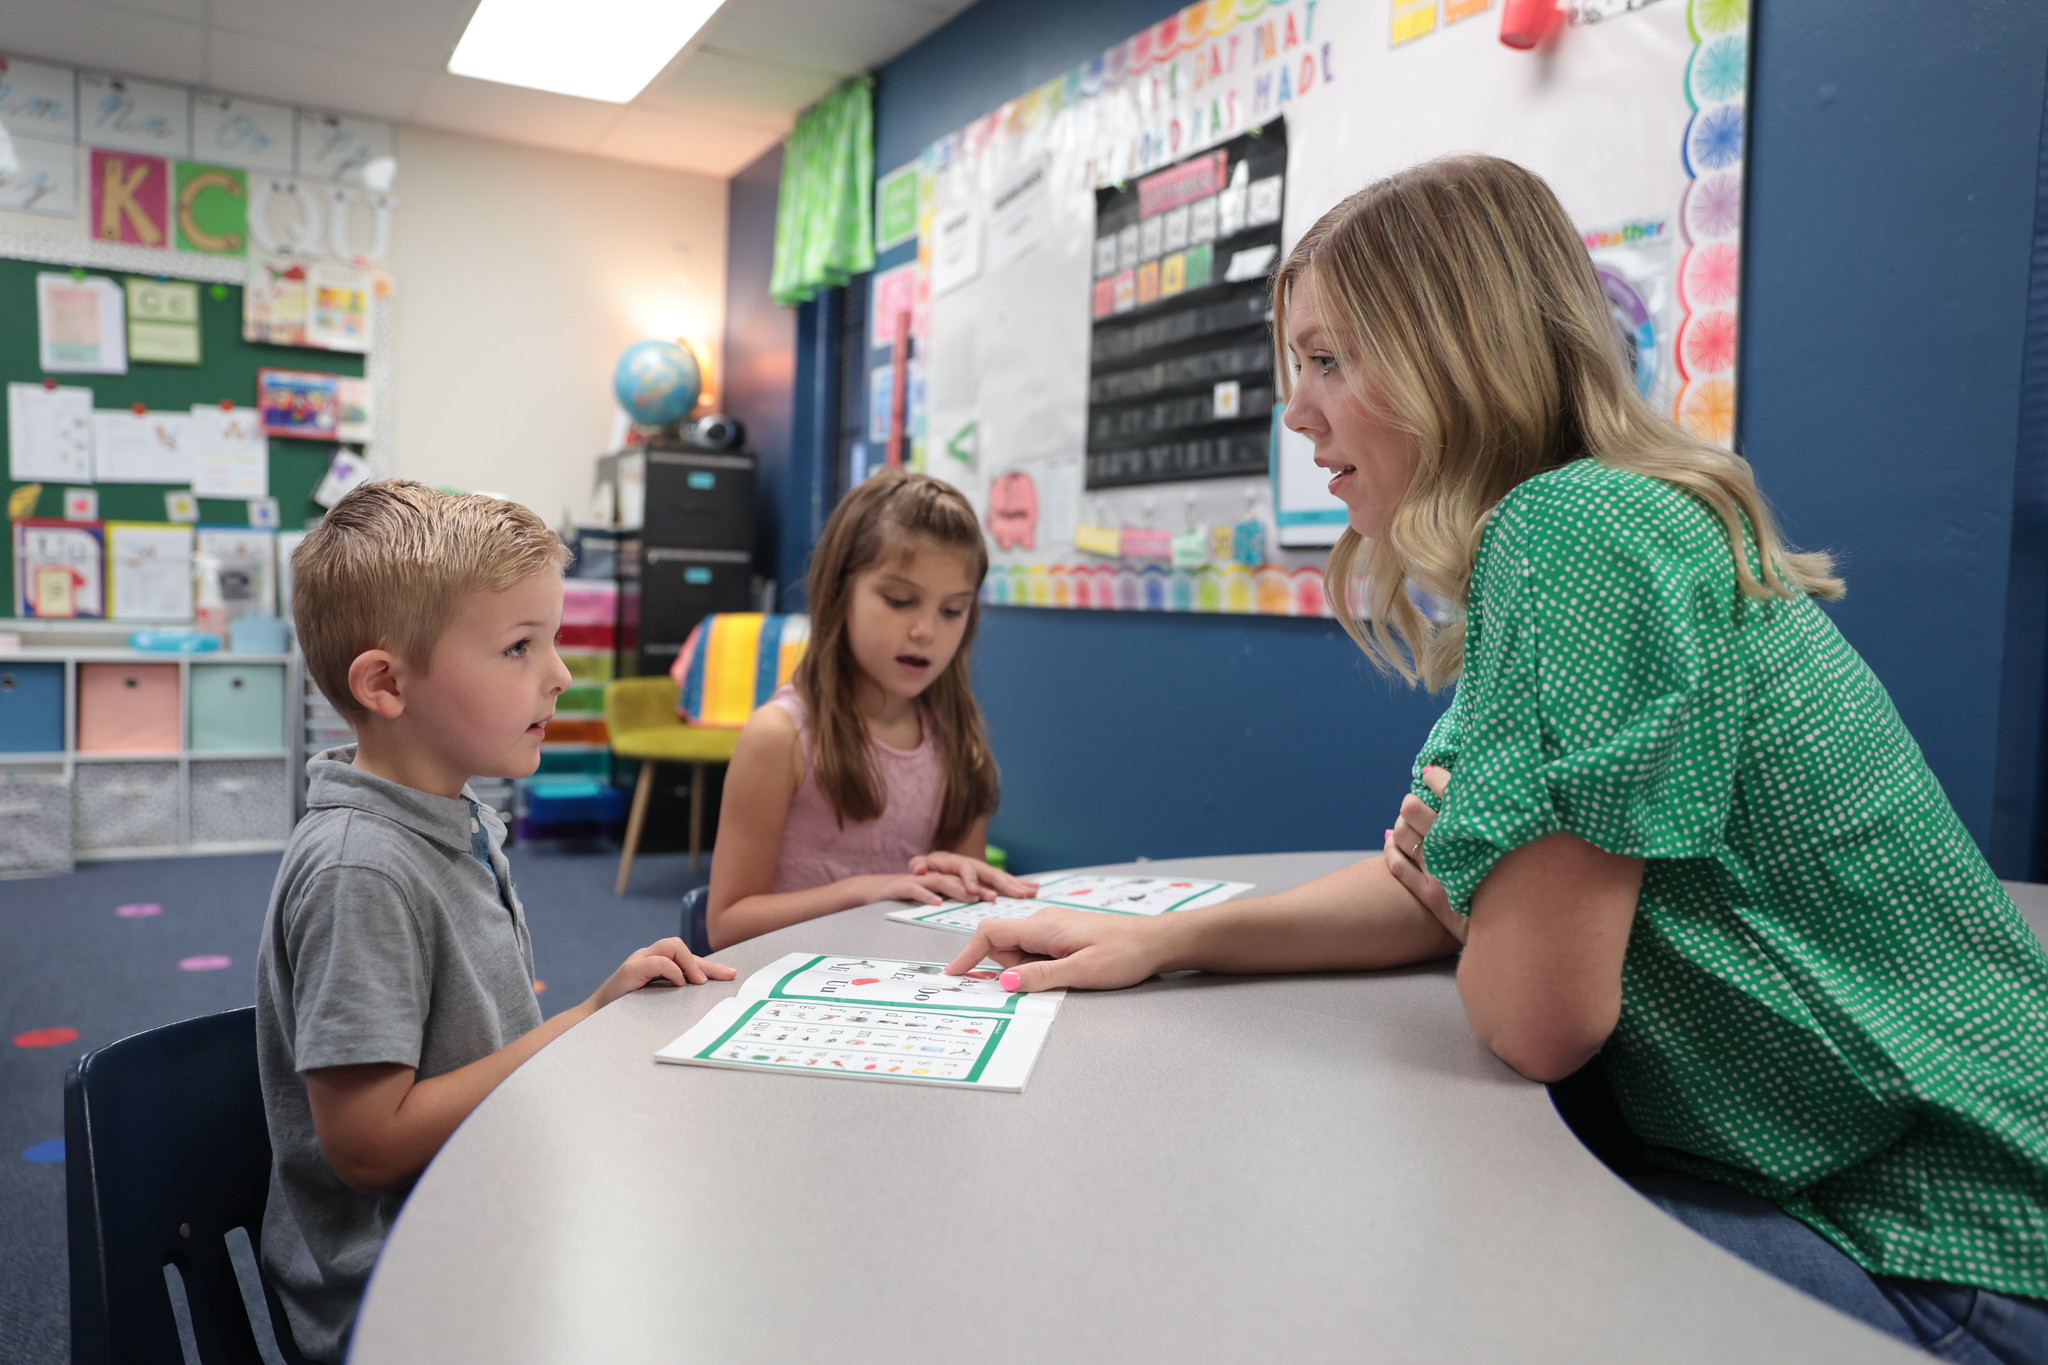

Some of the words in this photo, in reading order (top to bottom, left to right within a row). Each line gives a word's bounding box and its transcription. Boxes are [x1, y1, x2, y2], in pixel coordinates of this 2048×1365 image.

[1194, 35, 1240, 91] DAY
[1253, 41, 1333, 115] MADE
[103, 158, 162, 245] K
[178, 172, 242, 252] C
[820, 980, 849, 993] Uu
[914, 986, 941, 1001] Oo
